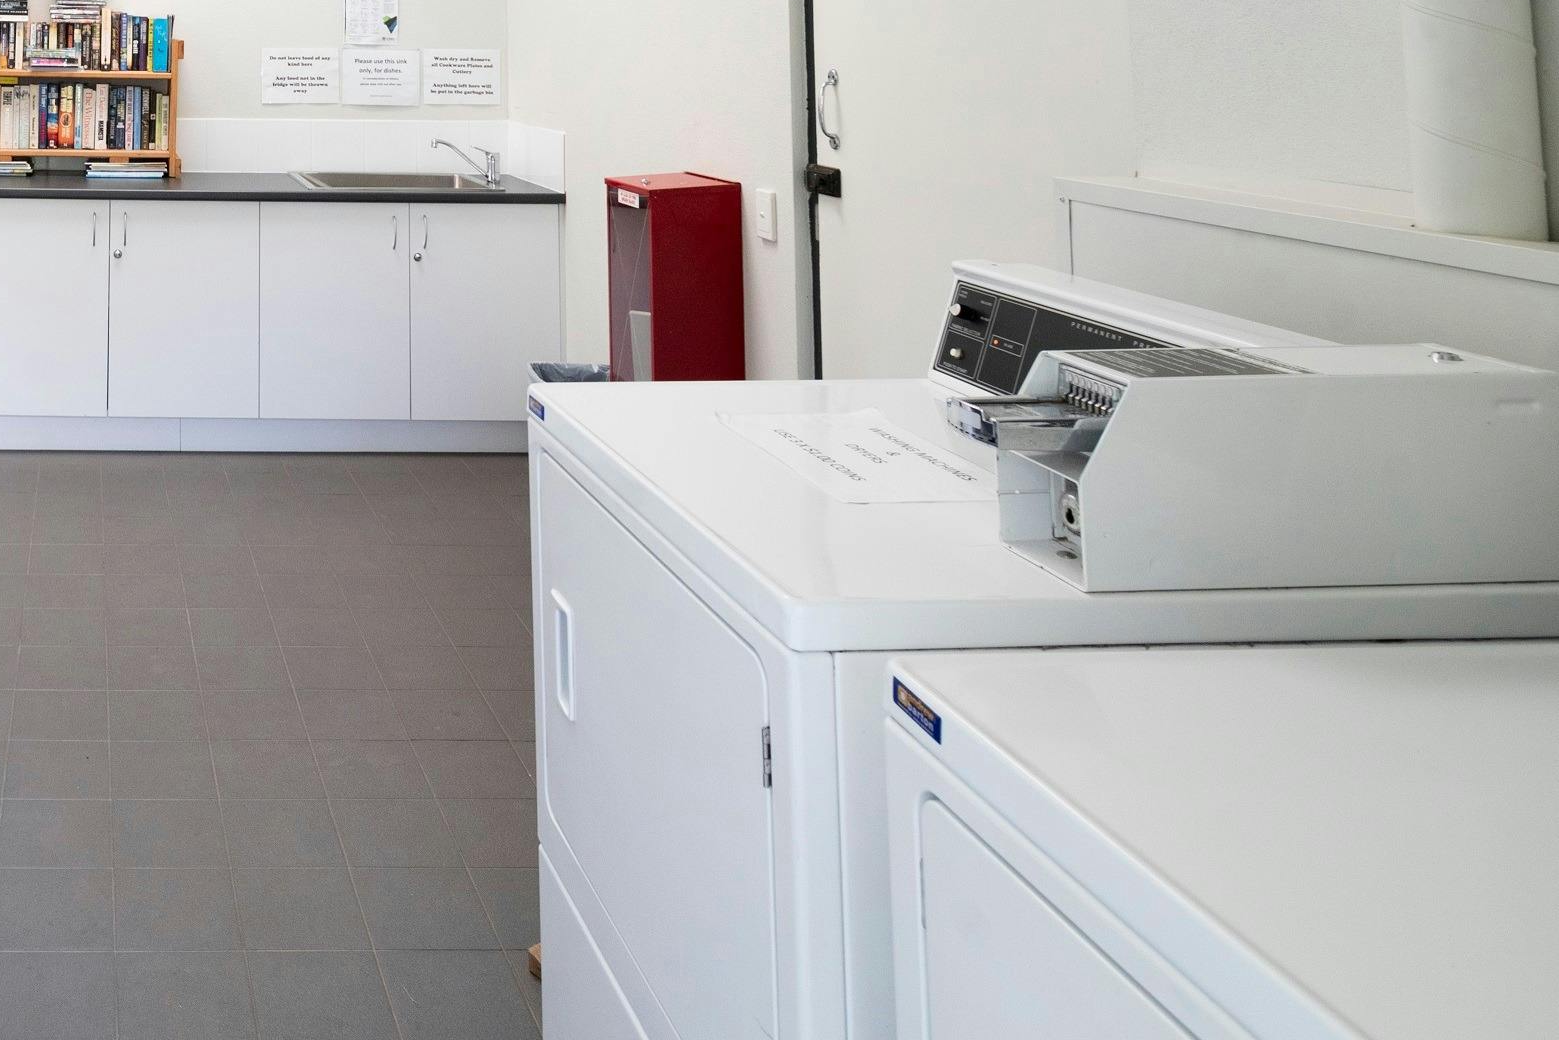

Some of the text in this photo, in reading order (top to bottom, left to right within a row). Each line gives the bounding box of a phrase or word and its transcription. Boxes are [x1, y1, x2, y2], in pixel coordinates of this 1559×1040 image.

[1070, 321, 1123, 342] PERMANENT
[845, 442, 888, 464] DRYERS
[869, 426, 978, 482] WASHING MACHINES
[830, 463, 867, 481] COINS
